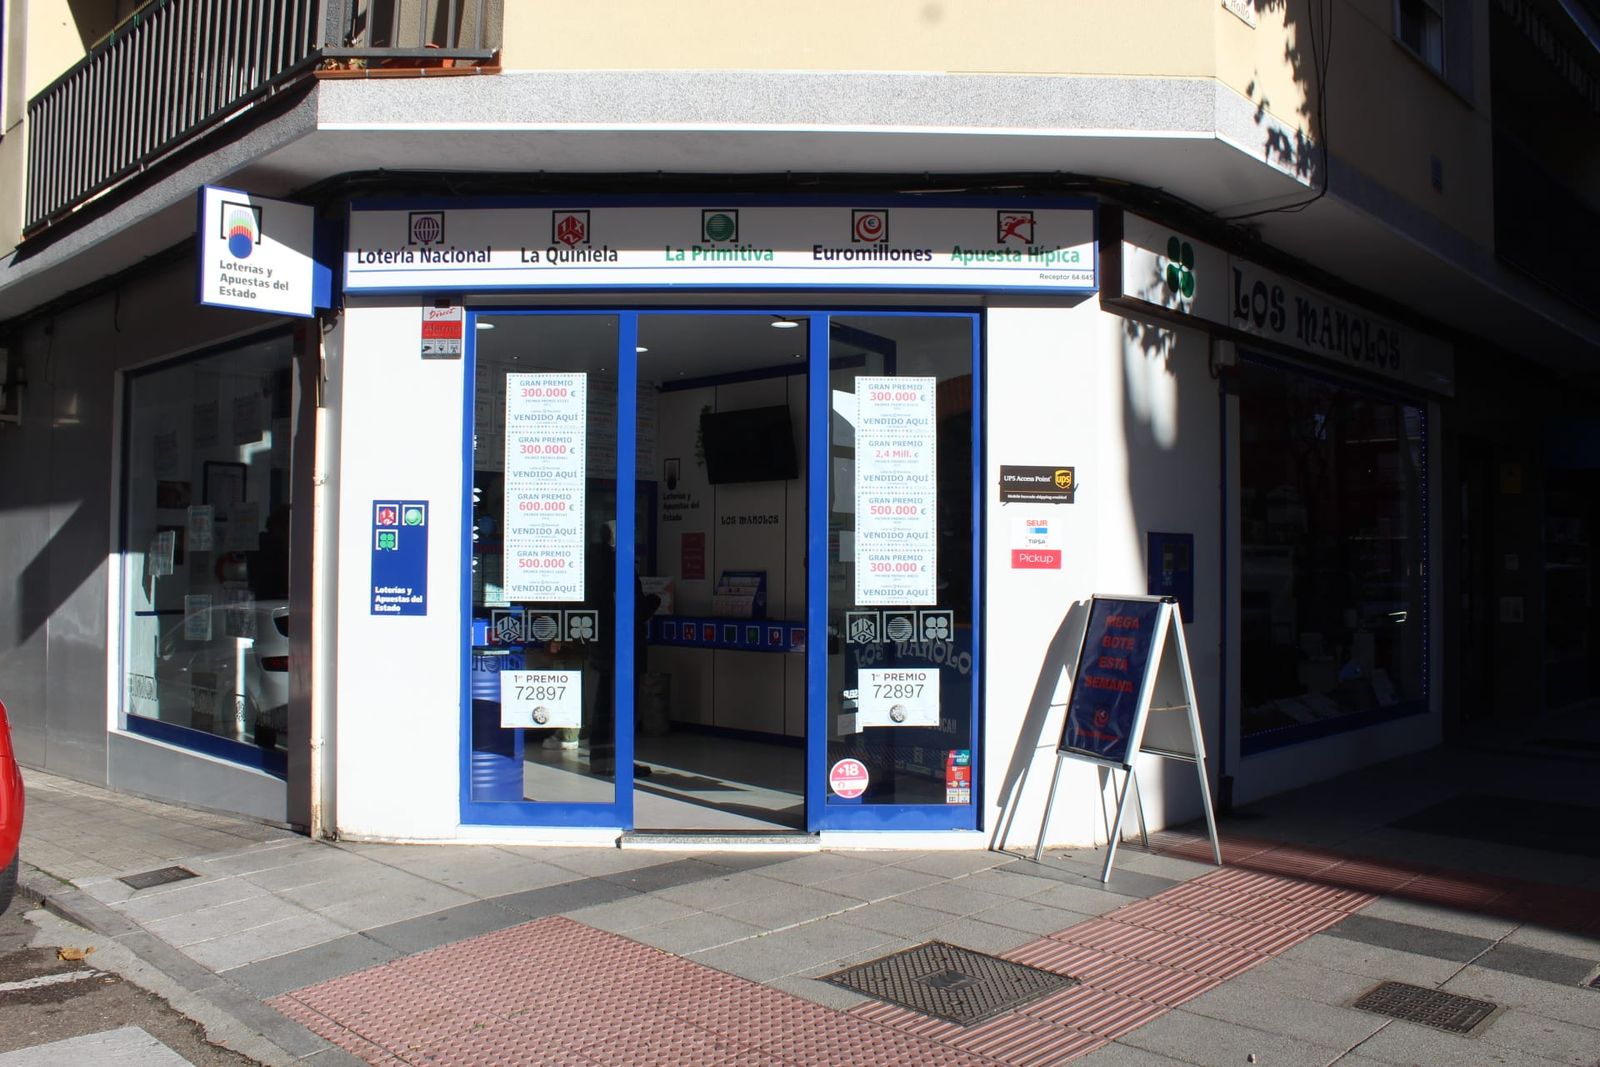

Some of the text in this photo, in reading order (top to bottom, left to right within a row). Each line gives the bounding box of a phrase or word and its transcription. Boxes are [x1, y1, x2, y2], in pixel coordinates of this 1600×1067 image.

[357, 246, 491, 265] Lotería Nacional
[521, 246, 618, 266] La Quiniela
[665, 244, 774, 262] La Primitiva
[813, 244, 932, 262] Euromillones
[951, 245, 1080, 267] Apuesta Hípica
[219, 260, 273, 278] Loterías y
[220, 273, 289, 291] Apuestas del
[1039, 272, 1070, 282] Receptor
[219, 286, 256, 300] Estado
[1232, 266, 1401, 371] LOS MANOLOS
[521, 388, 567, 397] 300.000
[870, 392, 916, 401] 300.000
[520, 445, 566, 454] 300.000
[1057, 474, 1071, 485] ups
[519, 502, 566, 511] 600.000
[870, 506, 917, 515] 500.000
[721, 516, 736, 525] LOS
[519, 559, 565, 568] 500.000
[1019, 554, 1054, 564] Pickup
[870, 563, 917, 572] 300.000
[375, 586, 412, 595] Loterías y
[375, 596, 410, 604] Apuestas
[1105, 615, 1139, 629] MEGA
[1102, 635, 1136, 651] BOTE
[1099, 656, 1128, 671] ESTA
[526, 675, 568, 683] PREMIO
[884, 673, 926, 681] PREMIO
[1084, 676, 1133, 692] SEMANA
[515, 686, 566, 700] 72897
[873, 684, 924, 698] 72897
[838, 764, 859, 776] +18
